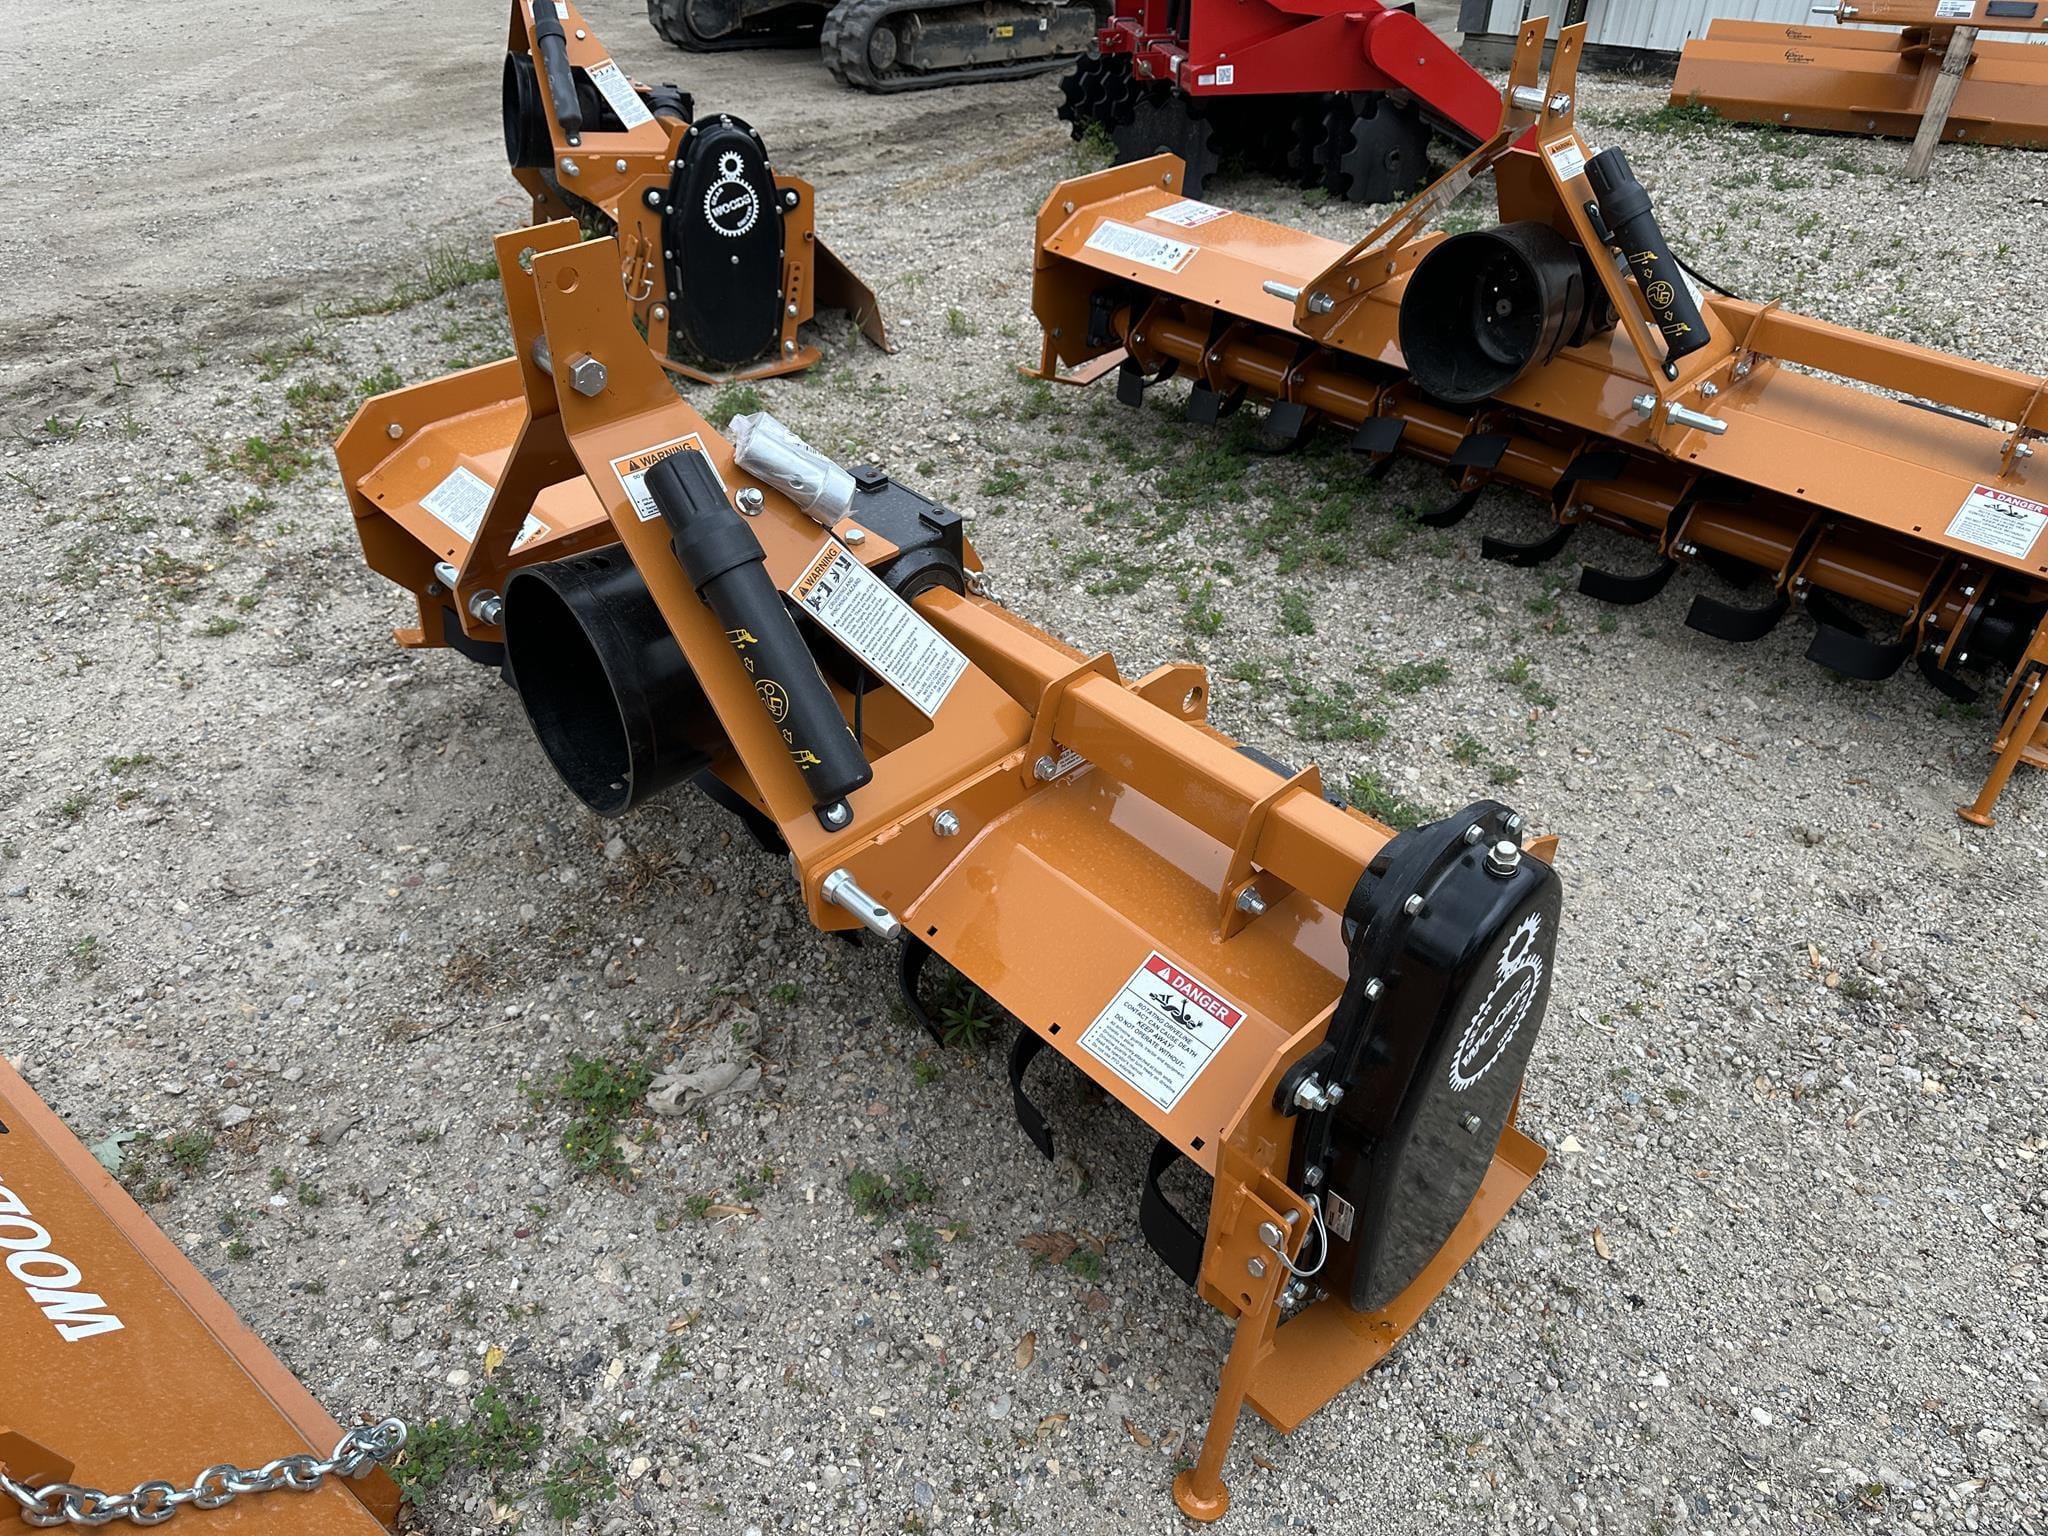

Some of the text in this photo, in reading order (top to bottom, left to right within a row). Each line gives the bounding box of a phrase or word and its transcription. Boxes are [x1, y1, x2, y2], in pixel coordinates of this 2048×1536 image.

[711, 193, 751, 217] WOODS
[1997, 494, 2043, 513] DANGER
[805, 548, 838, 587] WARNING
[1170, 975, 1230, 1021] DANGER
[1113, 1013, 1123, 1022] DO
[1122, 1019, 1134, 1030] NOT
[1133, 1028, 1159, 1048] OPERATE
[1122, 1001, 1197, 1058] CONTACT CAN CAUSE DEATH
[1135, 1019, 1174, 1050] KEEP AWAY!
[1136, 1002, 1192, 1044] ROTATING DRIVELINE
[1461, 975, 1531, 1067] WOODS
[0, 1175, 125, 1342] WOOD
